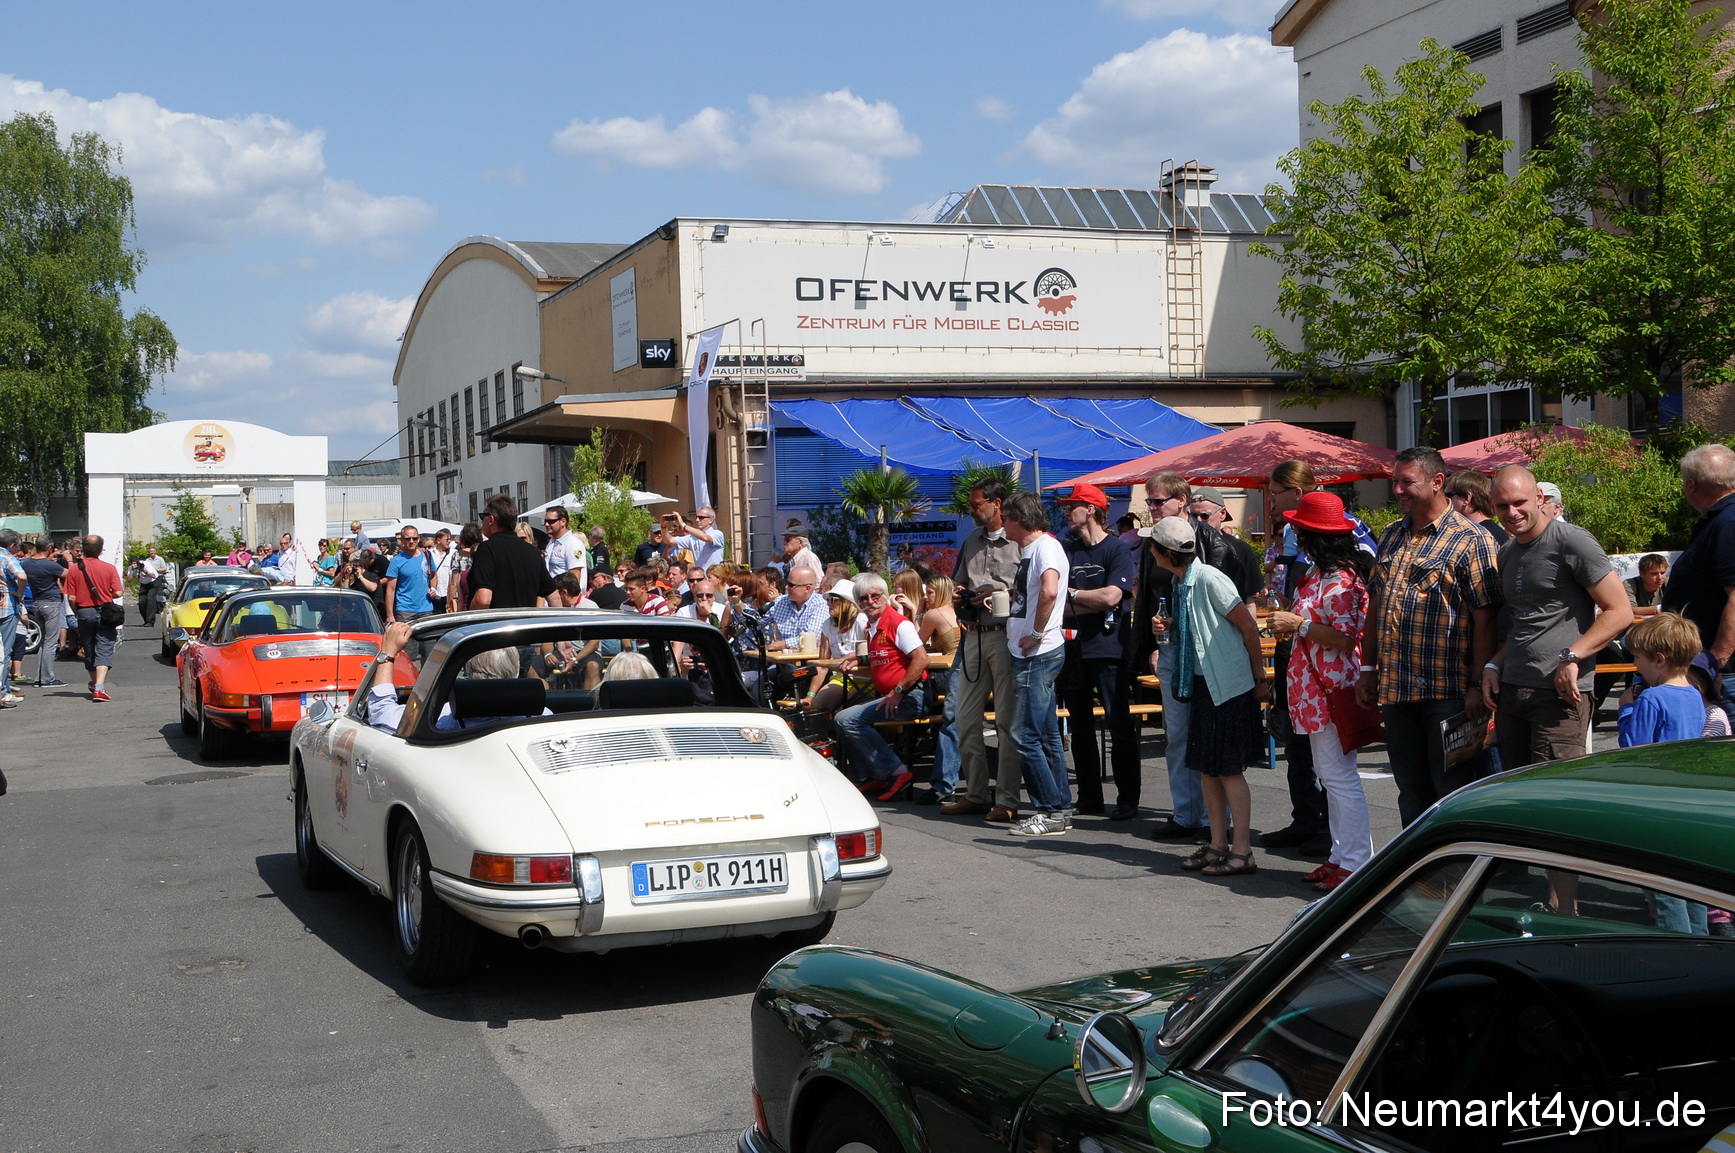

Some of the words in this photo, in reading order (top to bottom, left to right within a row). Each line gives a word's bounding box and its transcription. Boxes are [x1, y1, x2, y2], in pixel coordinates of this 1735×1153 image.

[795, 277, 1030, 305] OFENWERK
[796, 315, 886, 330] ZENTRUM
[934, 317, 1001, 331] MOBILE
[1007, 317, 1080, 332] CLASSIC
[645, 344, 672, 361] sky
[200, 424, 217, 433] ZIEL
[645, 814, 765, 826] PORSCHE
[649, 864, 691, 892] LIP
[706, 862, 721, 887] R
[728, 857, 783, 886] 911H
[638, 883, 645, 892] D
